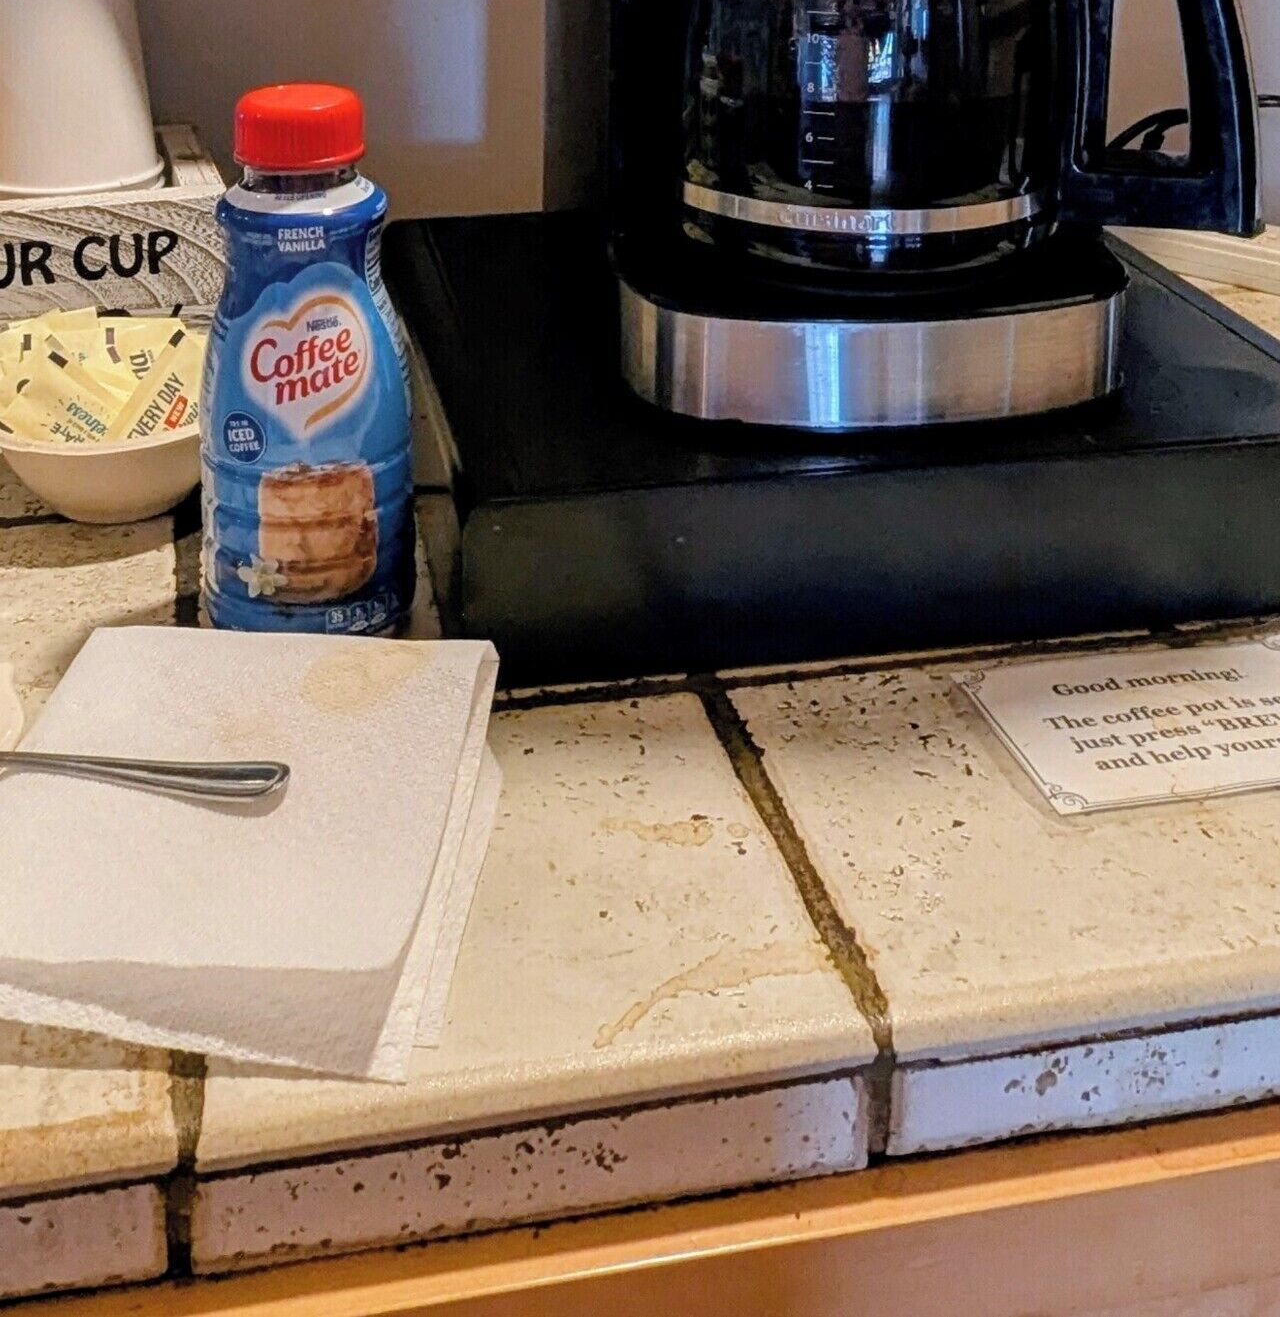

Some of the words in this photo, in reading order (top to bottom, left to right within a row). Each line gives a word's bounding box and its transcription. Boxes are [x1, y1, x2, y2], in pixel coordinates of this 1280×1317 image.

[807, 33, 819, 44] 10
[807, 82, 815, 93] 8
[805, 132, 813, 142] 6
[804, 180, 813, 190] 4
[278, 226, 324, 240] FRENCH
[73, 230, 179, 281] CUP
[278, 239, 326, 253] VANILLA
[250, 328, 352, 382] Coffee
[157, 372, 184, 405] DAY
[275, 351, 360, 405] mate
[169, 400, 186, 424] NEW
[227, 427, 255, 442] ICED
[229, 440, 260, 452] COFFEE
[1052, 677, 1123, 697] Good
[1125, 668, 1243, 689] morning!
[1042, 711, 1096, 731] The
[1102, 704, 1181, 726] coffee
[1183, 696, 1228, 717] pot
[1231, 696, 1257, 709] is
[1070, 733, 1125, 754] just
[1128, 722, 1202, 747] press
[1094, 752, 1149, 772] and
[1150, 742, 1212, 765] help
